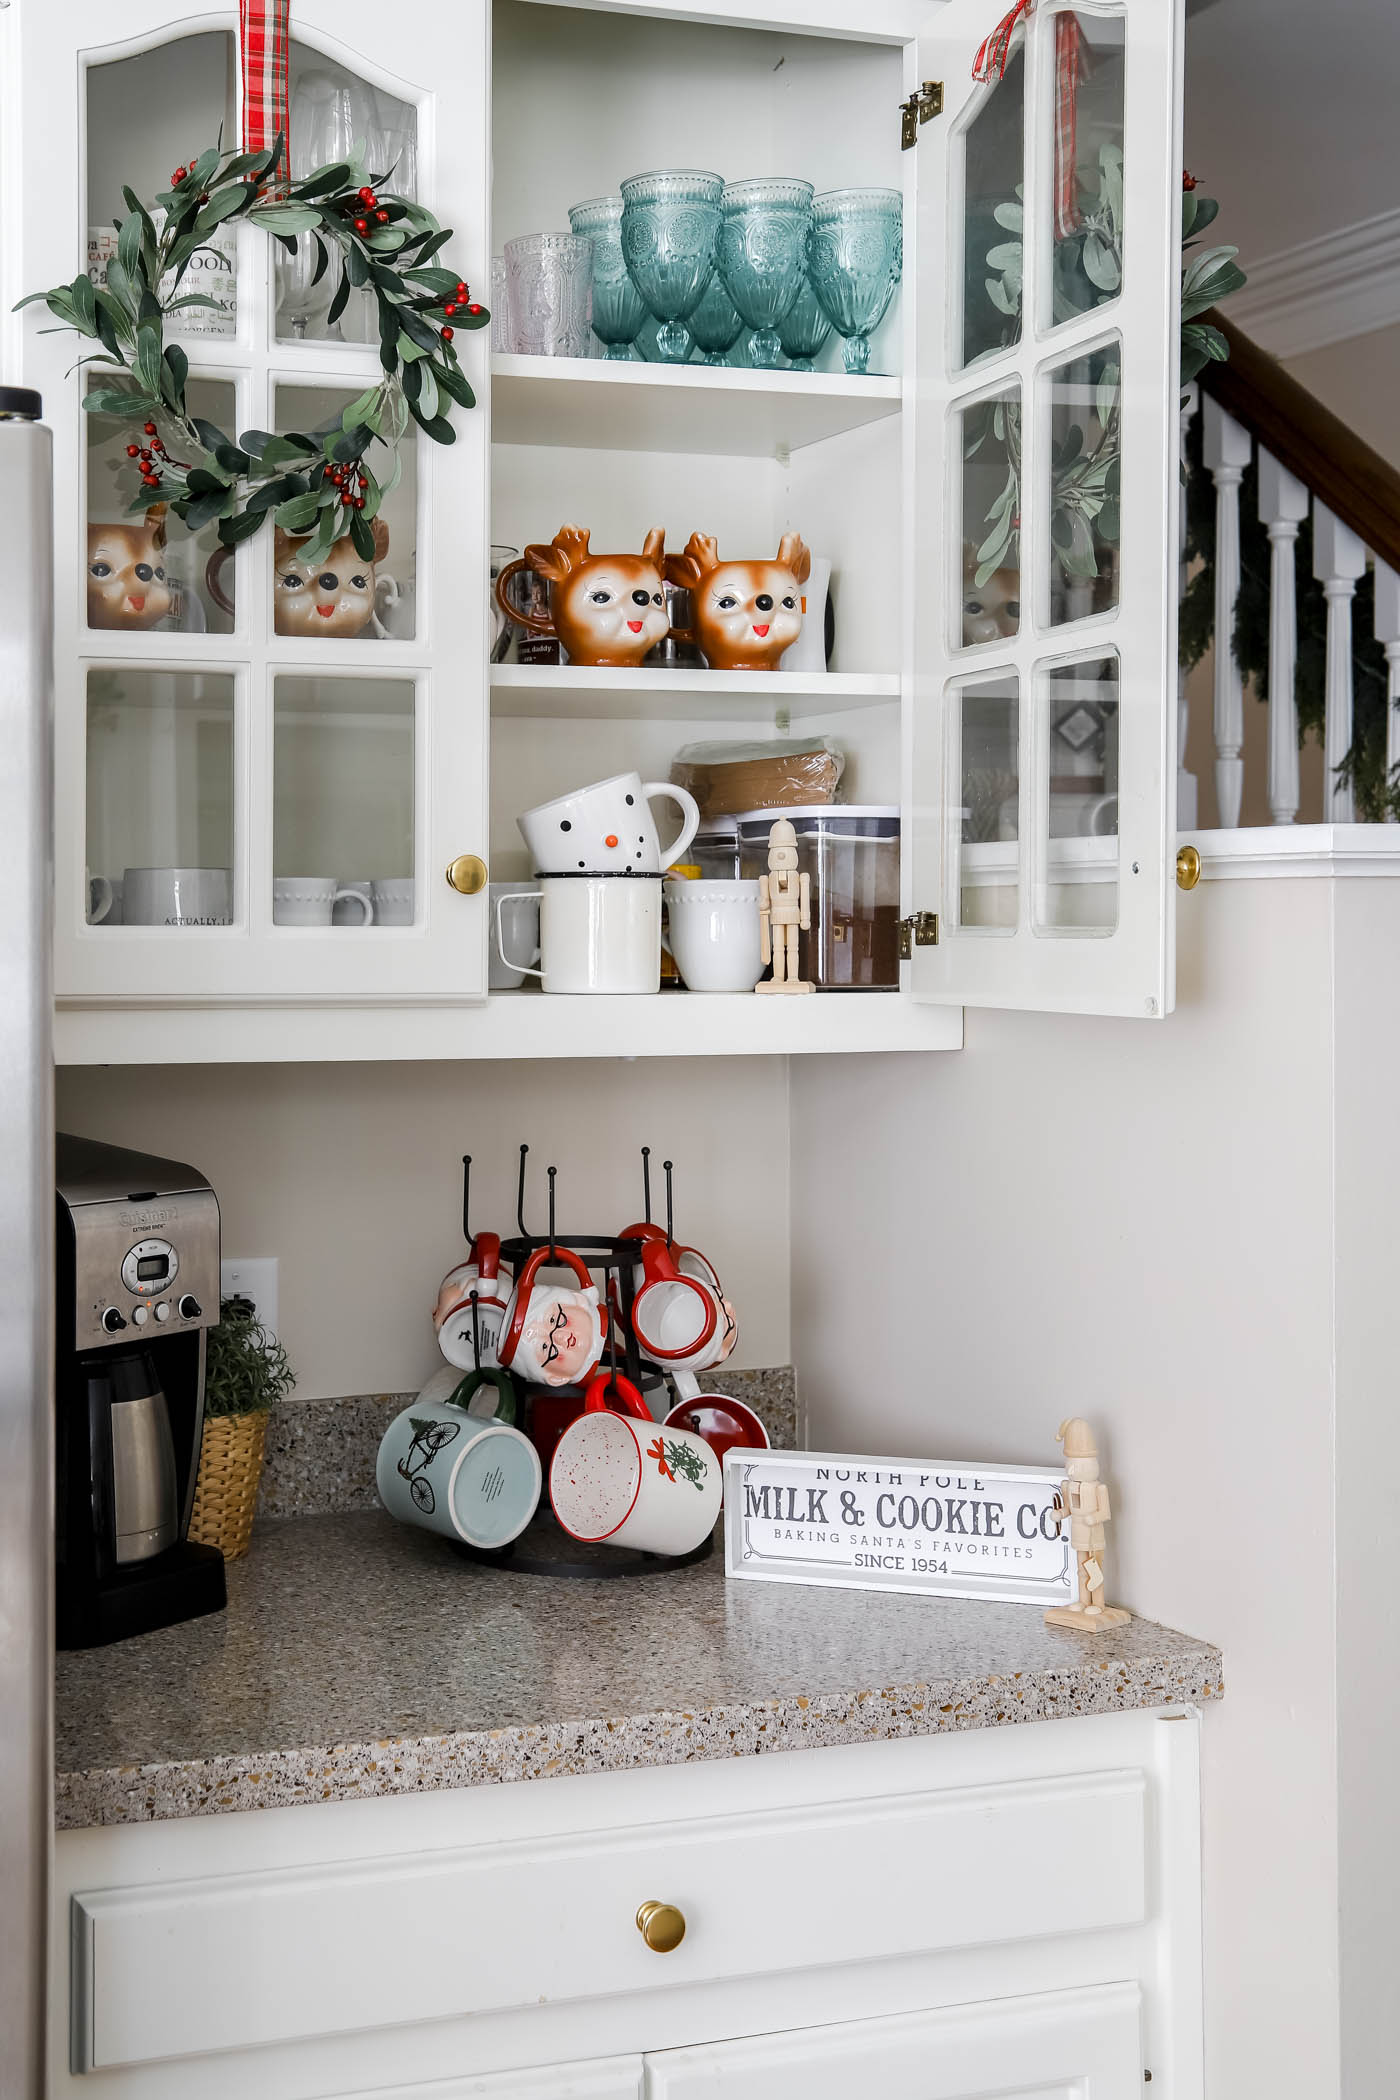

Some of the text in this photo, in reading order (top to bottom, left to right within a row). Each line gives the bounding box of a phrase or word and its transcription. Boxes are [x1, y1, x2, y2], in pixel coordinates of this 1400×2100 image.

[815, 1468, 985, 1492] NORTH POLE
[743, 1484, 830, 1524] MILK
[839, 1490, 865, 1527] &
[876, 1493, 1005, 1538] COOKIE
[773, 1528, 841, 1544] BAKING
[932, 1540, 1034, 1560] FAVORITES
[853, 1553, 949, 1574] SINCE 1954
